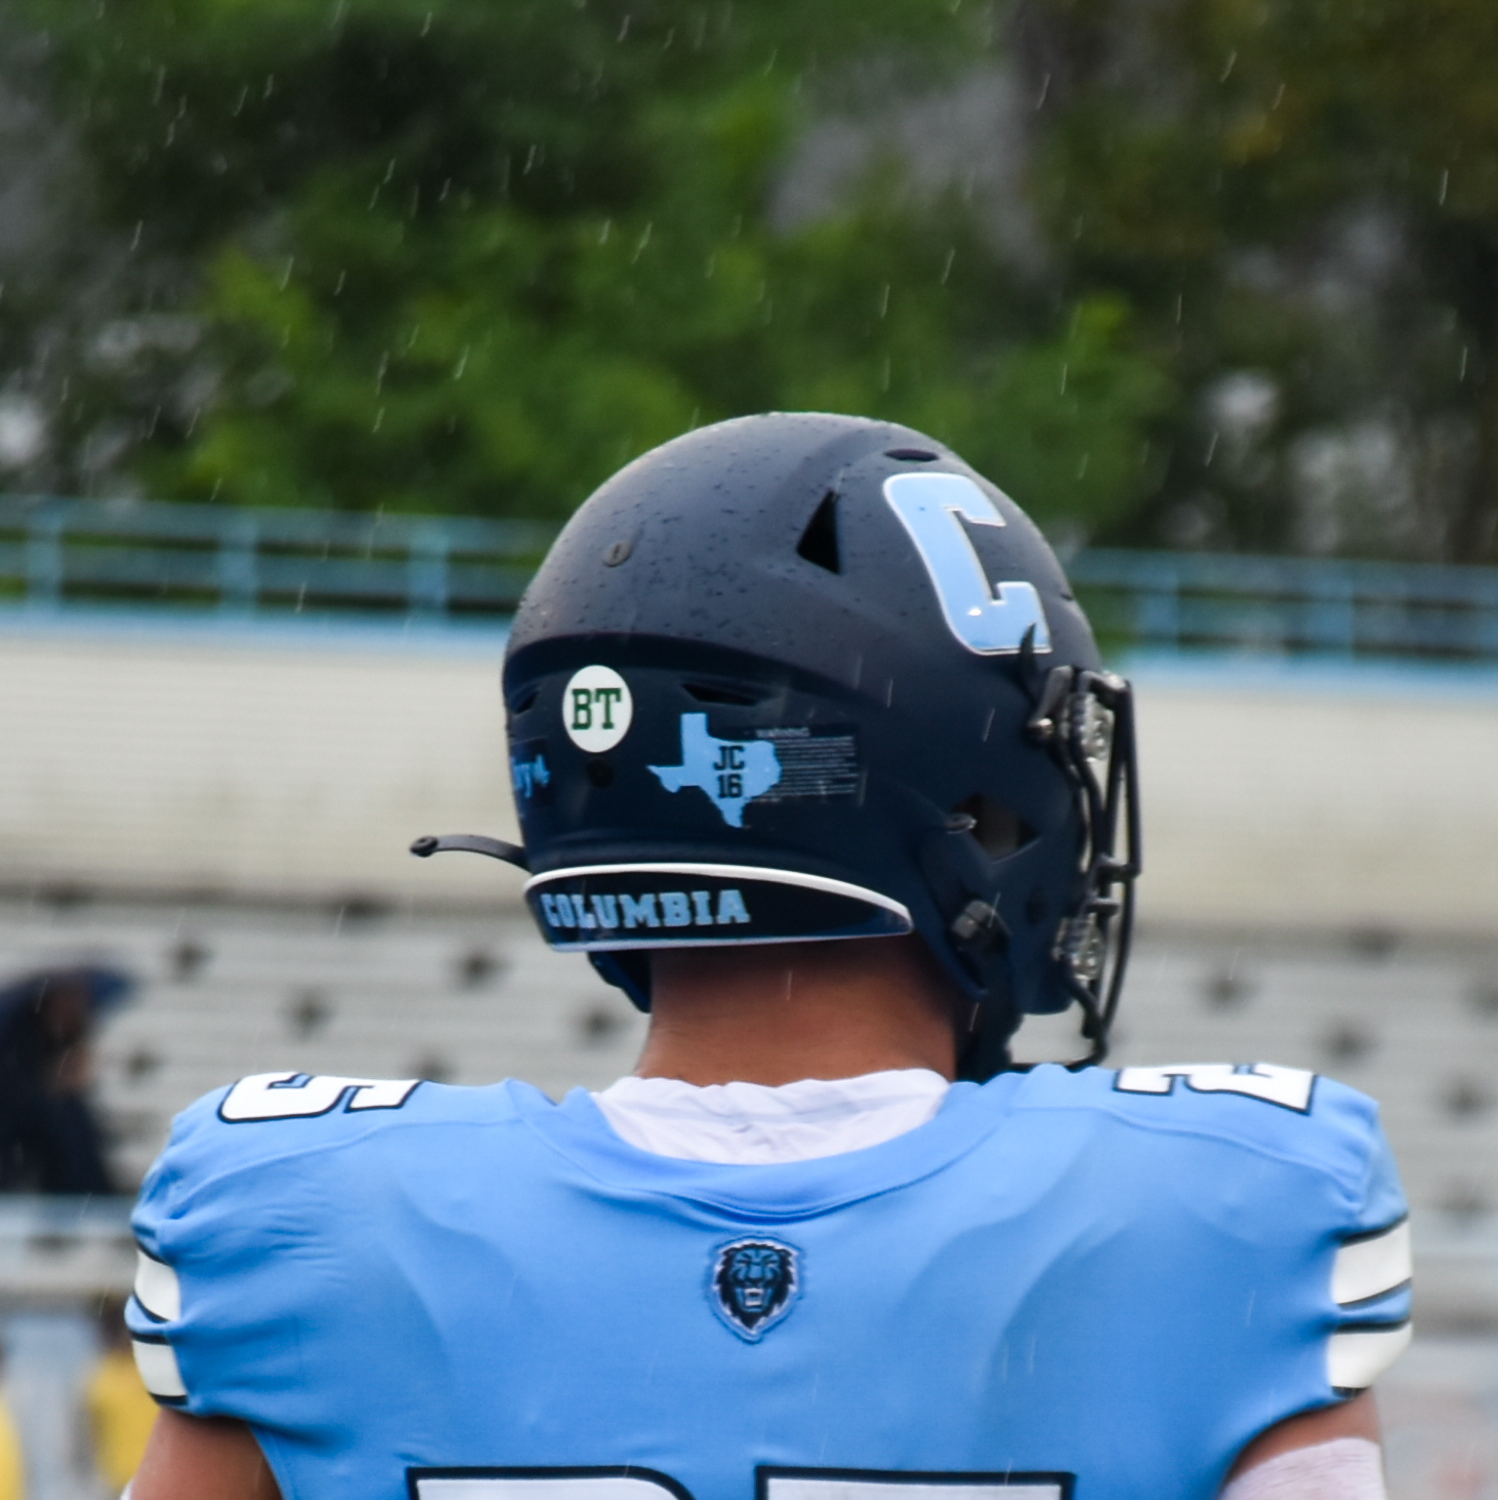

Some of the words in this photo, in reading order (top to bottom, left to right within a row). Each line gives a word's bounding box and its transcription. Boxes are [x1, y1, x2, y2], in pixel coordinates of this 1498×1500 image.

[882, 471, 1053, 656] C
[571, 687, 622, 730] BT
[713, 745, 745, 771] JC
[717, 774, 743, 798] 16
[539, 889, 751, 929] COLUMBIA
